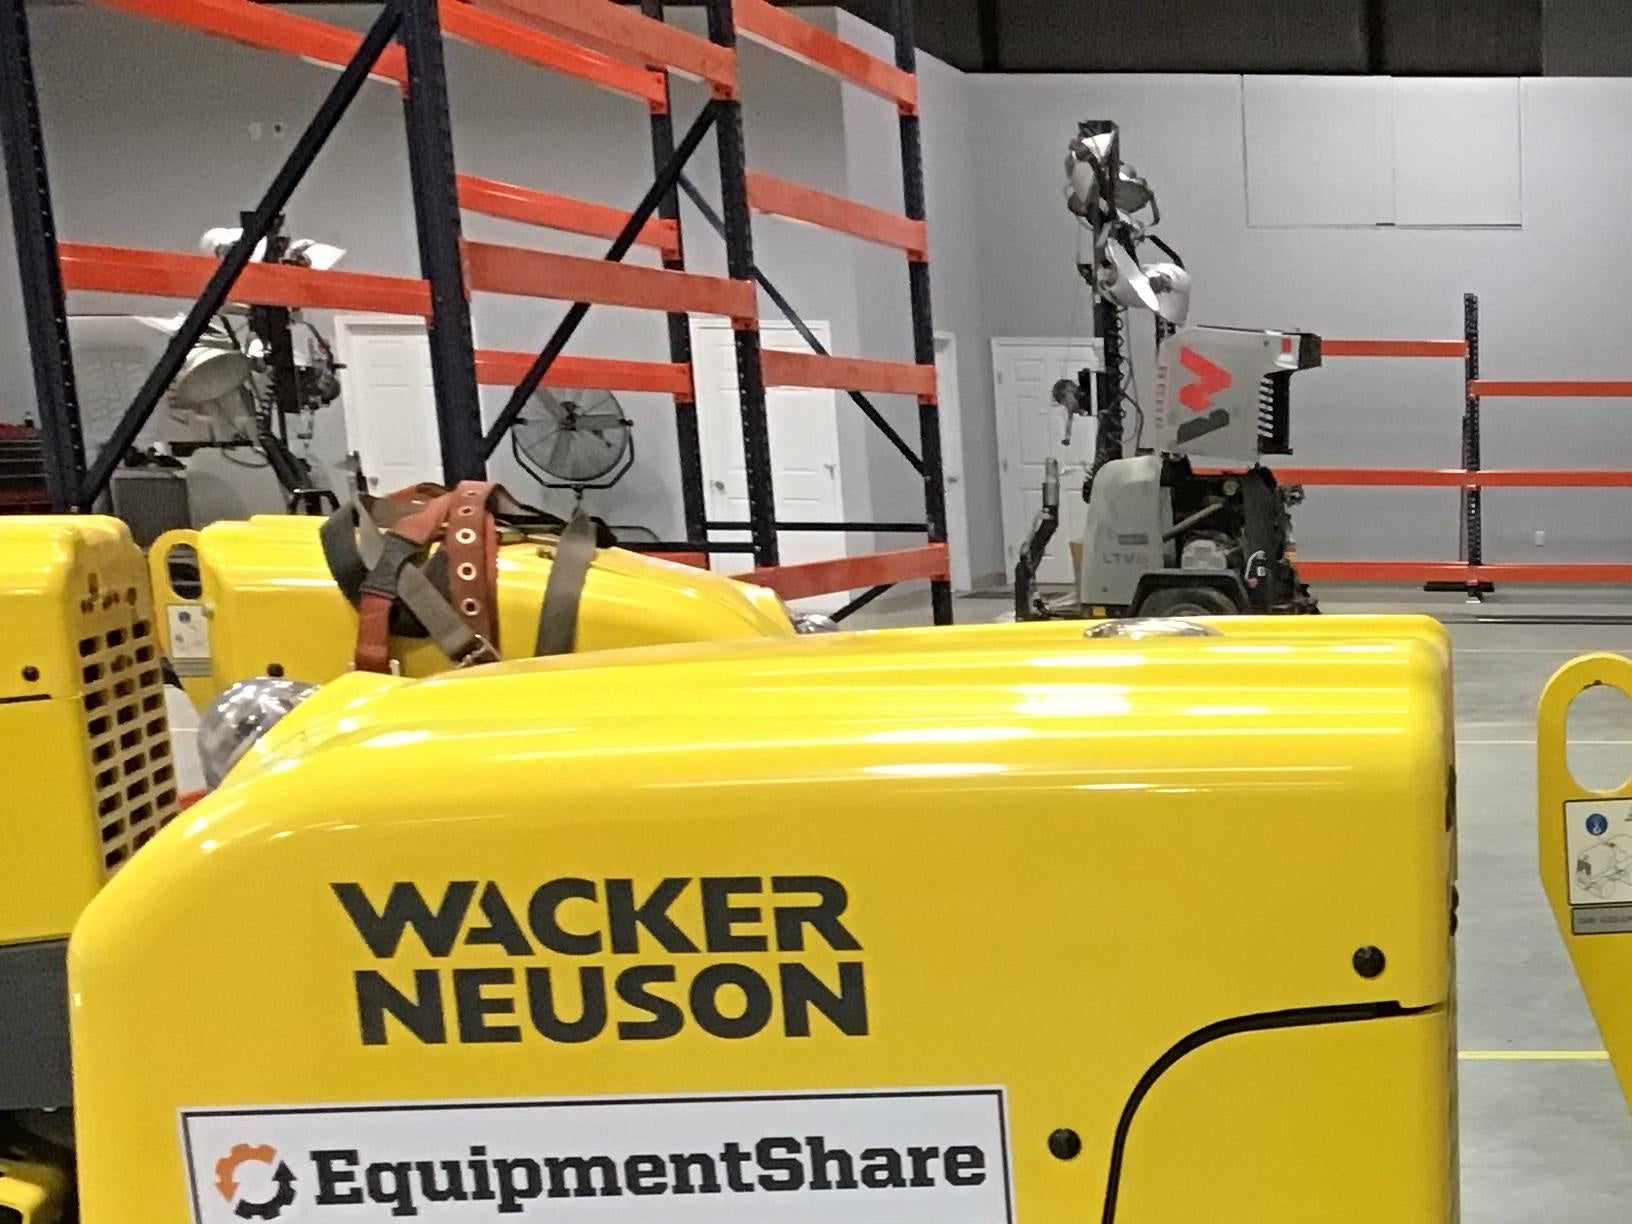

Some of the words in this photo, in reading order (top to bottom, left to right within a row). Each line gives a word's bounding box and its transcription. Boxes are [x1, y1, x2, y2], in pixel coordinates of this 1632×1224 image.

[332, 876, 863, 958] WACKER
[355, 962, 870, 1046] NEUSON
[311, 1136, 986, 1217] EquipmentShare
